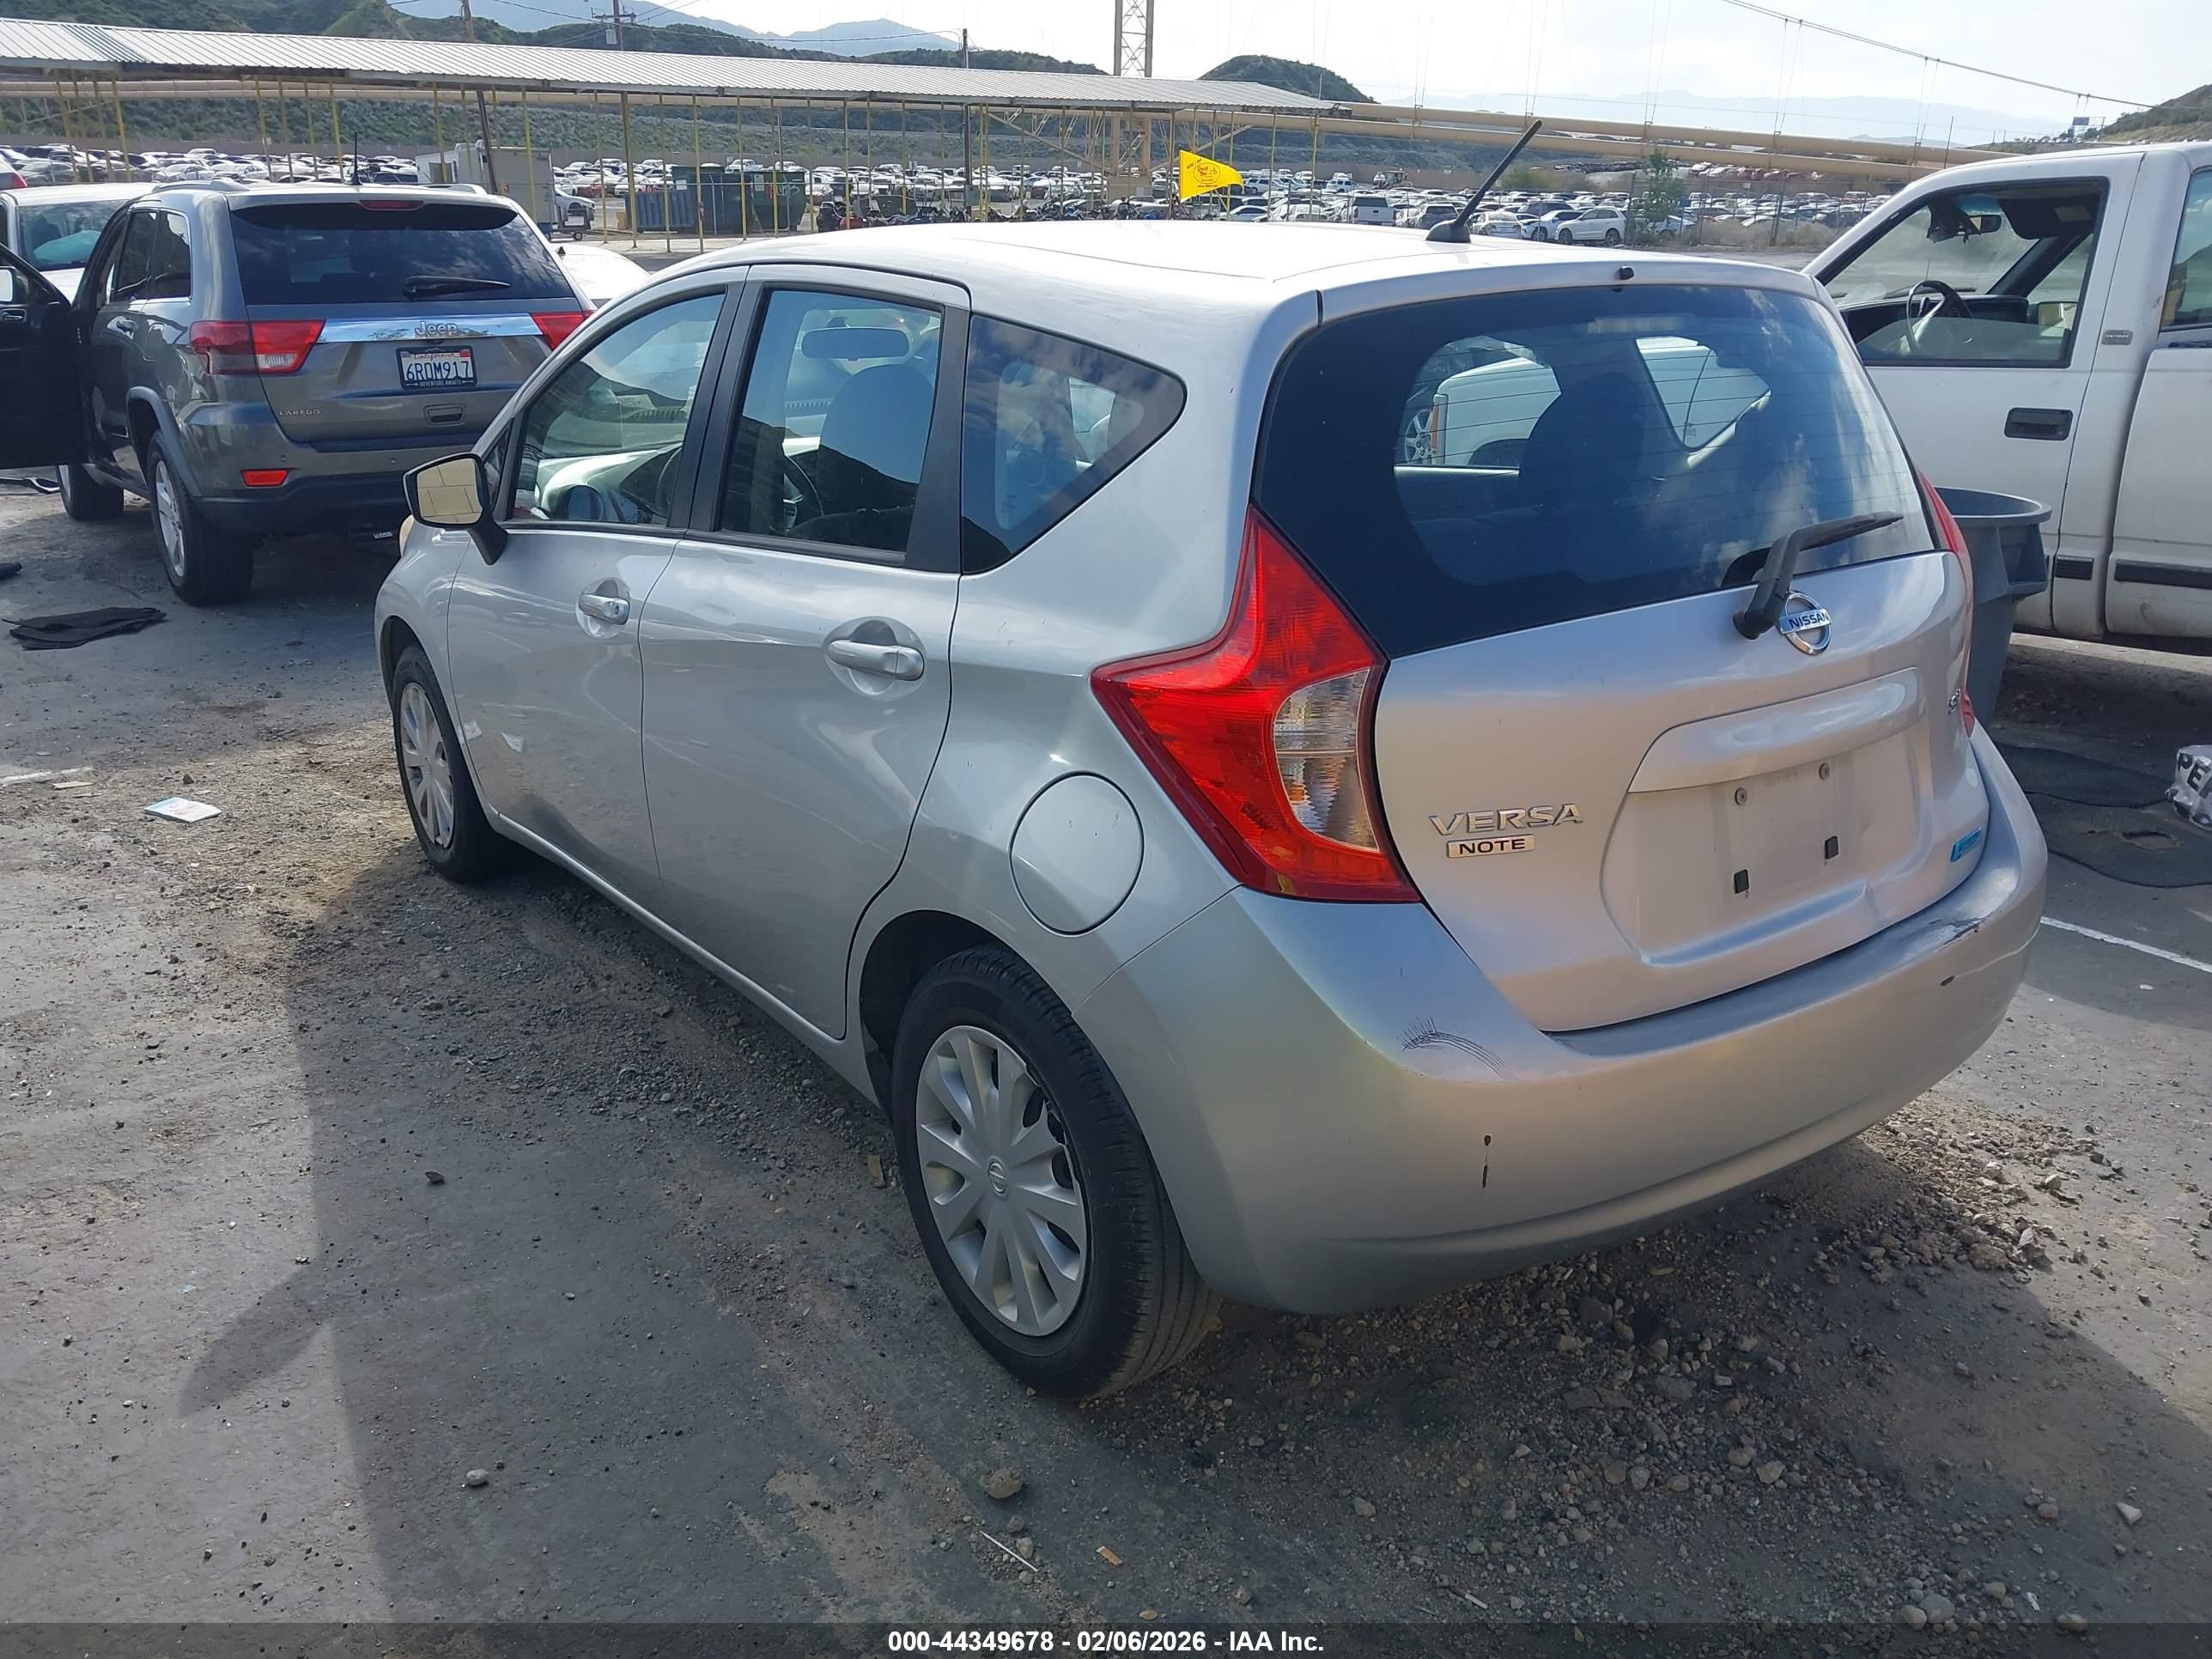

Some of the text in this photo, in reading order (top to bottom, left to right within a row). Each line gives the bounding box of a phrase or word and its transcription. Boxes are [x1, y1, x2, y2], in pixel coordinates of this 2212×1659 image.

[415, 321, 459, 336] Jeep
[1788, 611, 1829, 629] NISSAN
[1429, 803, 1583, 836] VERSA
[1460, 838, 1526, 855] NOTE
